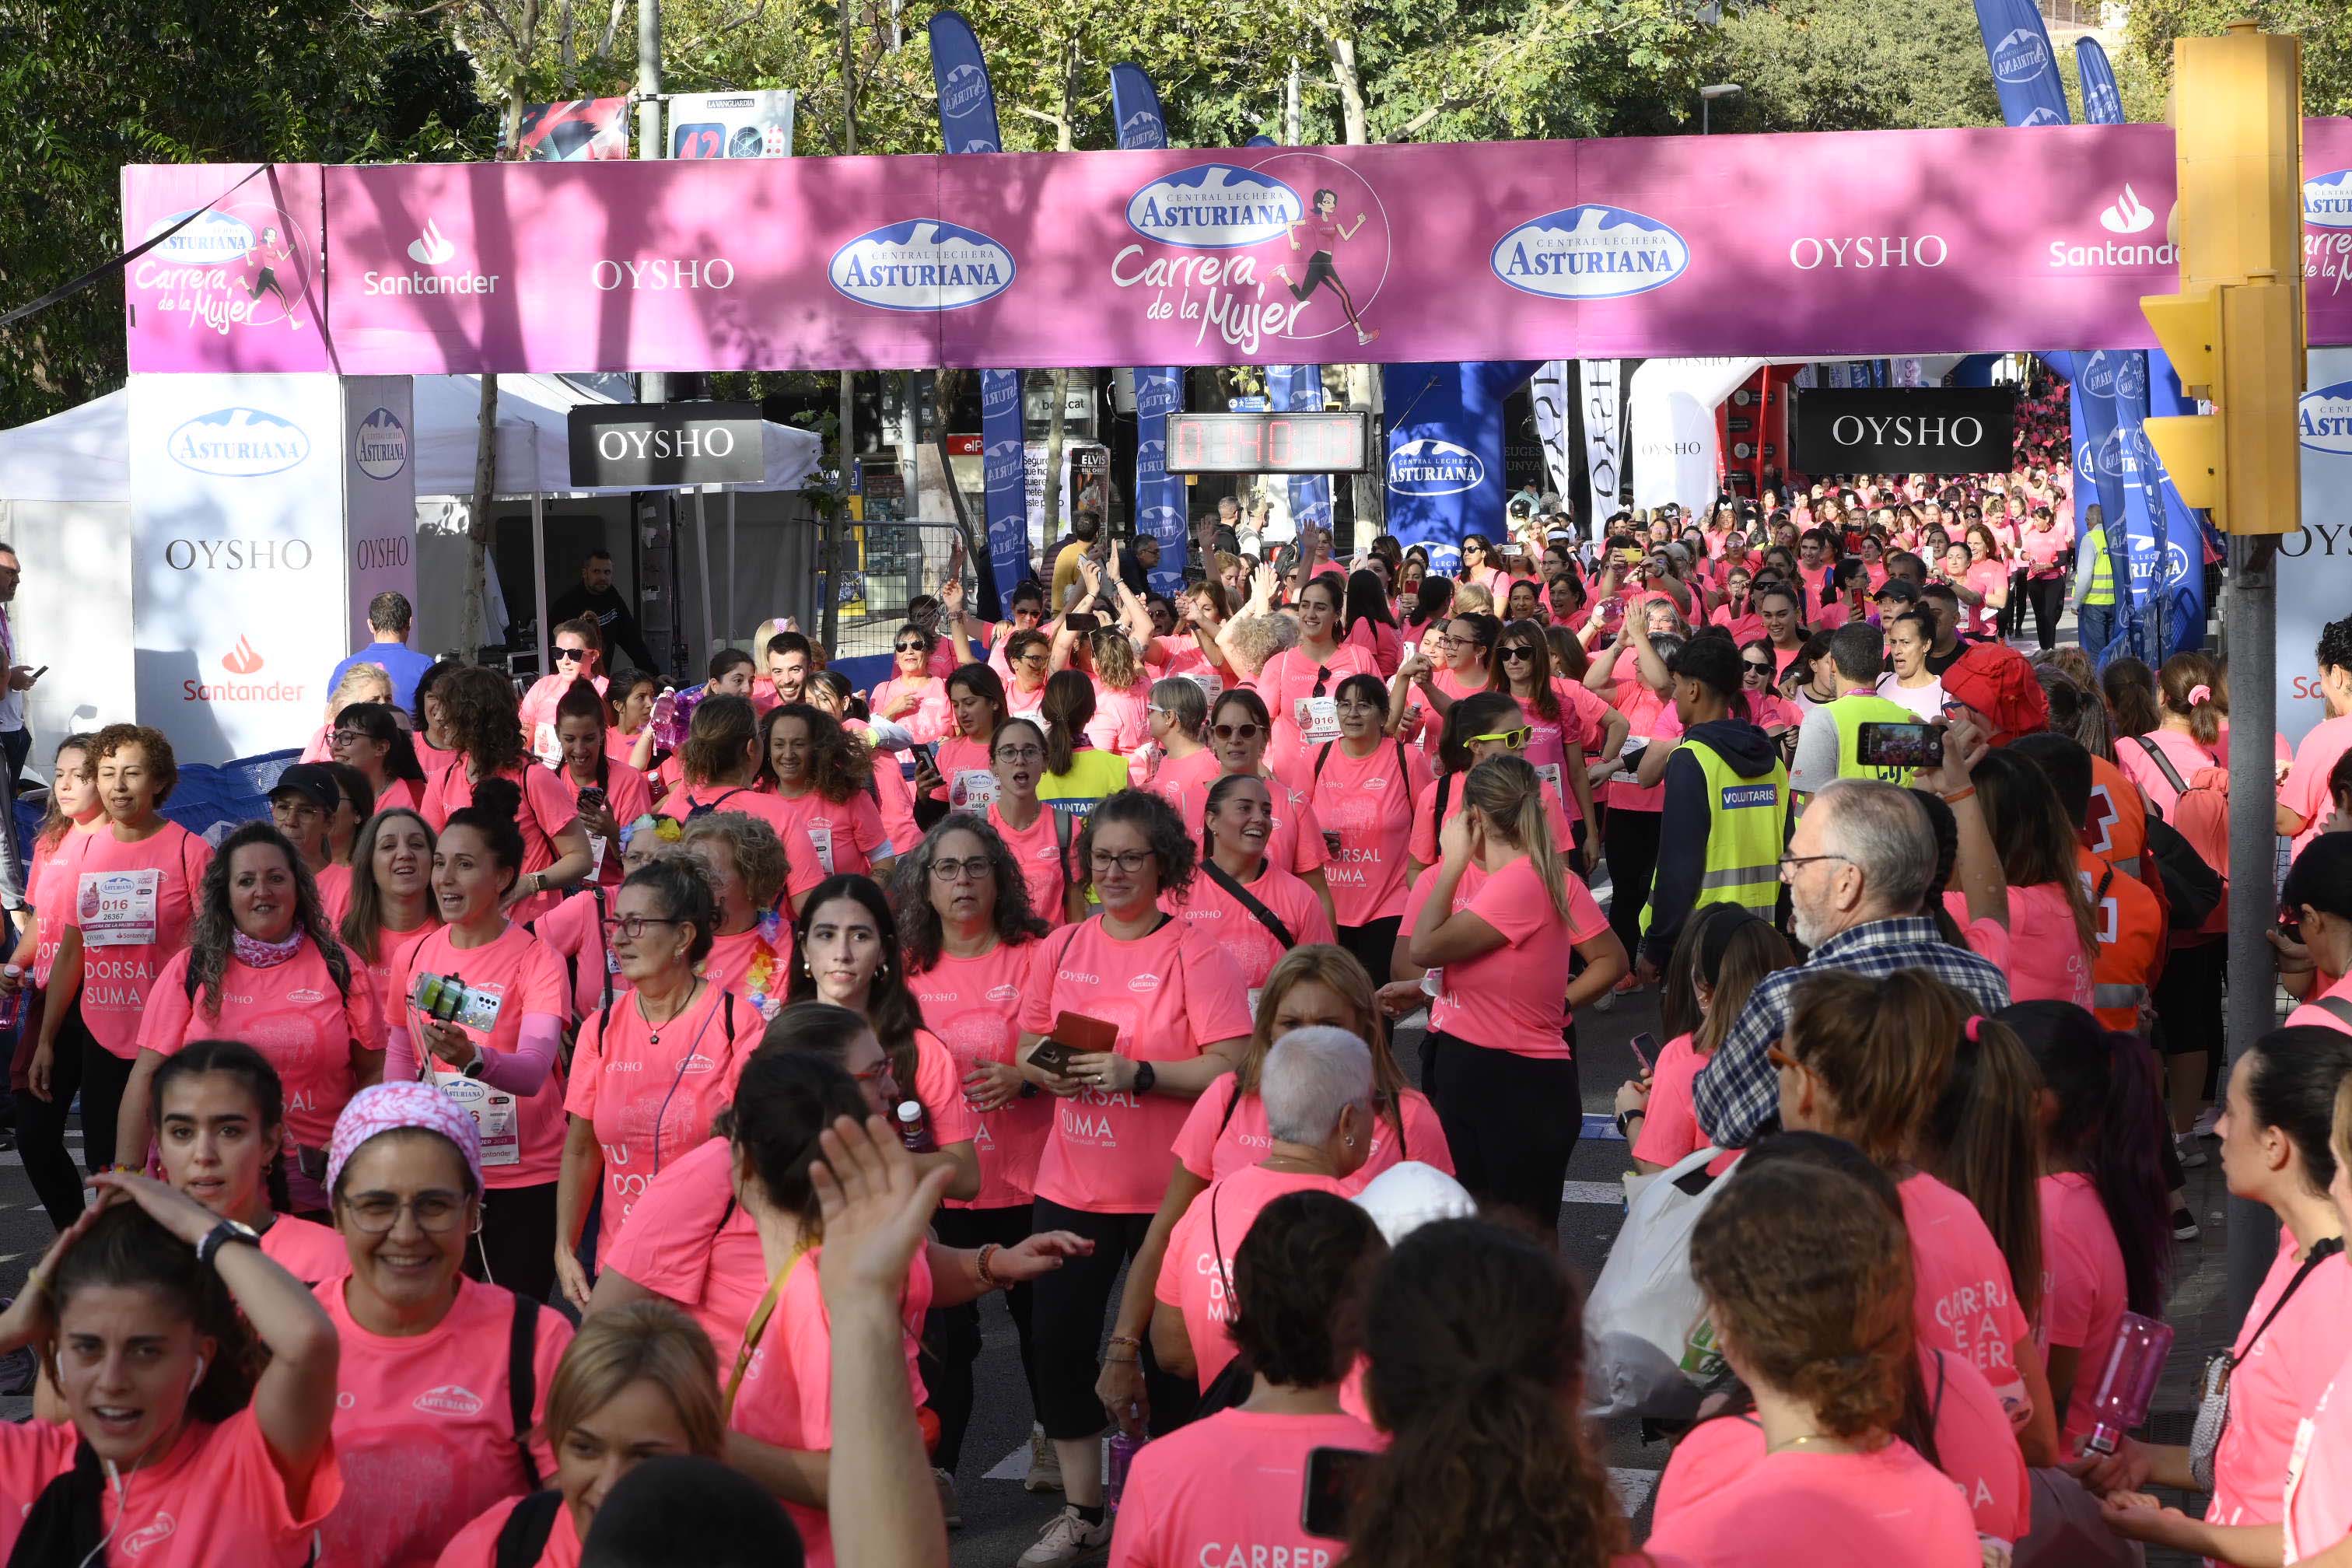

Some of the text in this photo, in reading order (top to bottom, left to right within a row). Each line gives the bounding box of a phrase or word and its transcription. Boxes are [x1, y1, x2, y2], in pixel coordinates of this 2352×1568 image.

[1167, 191, 1284, 202] CENTRAL LECHERA
[1139, 195, 1288, 227] ASTURIANA
[161, 236, 247, 250] STURIANA
[1537, 236, 1668, 248] CENTRAL LECHERA
[1790, 236, 1948, 270] OYSHO
[2304, 233, 2352, 255] arre
[871, 250, 995, 261] CENTRAL LECHERA
[1111, 244, 1257, 287] Carrera
[1506, 242, 1674, 276] ASTURIANA
[135, 261, 227, 289] Carrera
[591, 258, 735, 291] OYSHO
[843, 254, 1002, 287] ASTURIANA
[363, 271, 499, 295] Santander
[159, 287, 262, 336] de la Mujer
[1146, 282, 1311, 355] de la Mujer
[1832, 414, 1983, 447] OYSHO
[2299, 409, 2352, 437] ASTU
[180, 432, 300, 461] ASTURIANA
[359, 435, 404, 462] ASTURIANA
[598, 426, 734, 460] OYSHO
[1642, 441, 1701, 456] OYSHO
[1081, 454, 1106, 465] ELVIS
[1389, 462, 1478, 484] ASTURIANA
[165, 538, 313, 571] OYSHO
[357, 535, 409, 571] OYSHO
[184, 679, 305, 702] Santander
[1314, 716, 1334, 725] 016
[968, 793, 989, 802] 016
[1723, 789, 1775, 804] VOLUNTARIS
[1332, 848, 1381, 863] ORSAL
[102, 899, 129, 911] 016
[1185, 908, 1222, 920] OYSHO
[1059, 970, 1100, 985] OYSHO
[86, 985, 142, 1005] SUMA
[1062, 1108, 1114, 1139] SUMA
[480, 1150, 511, 1158] antander
